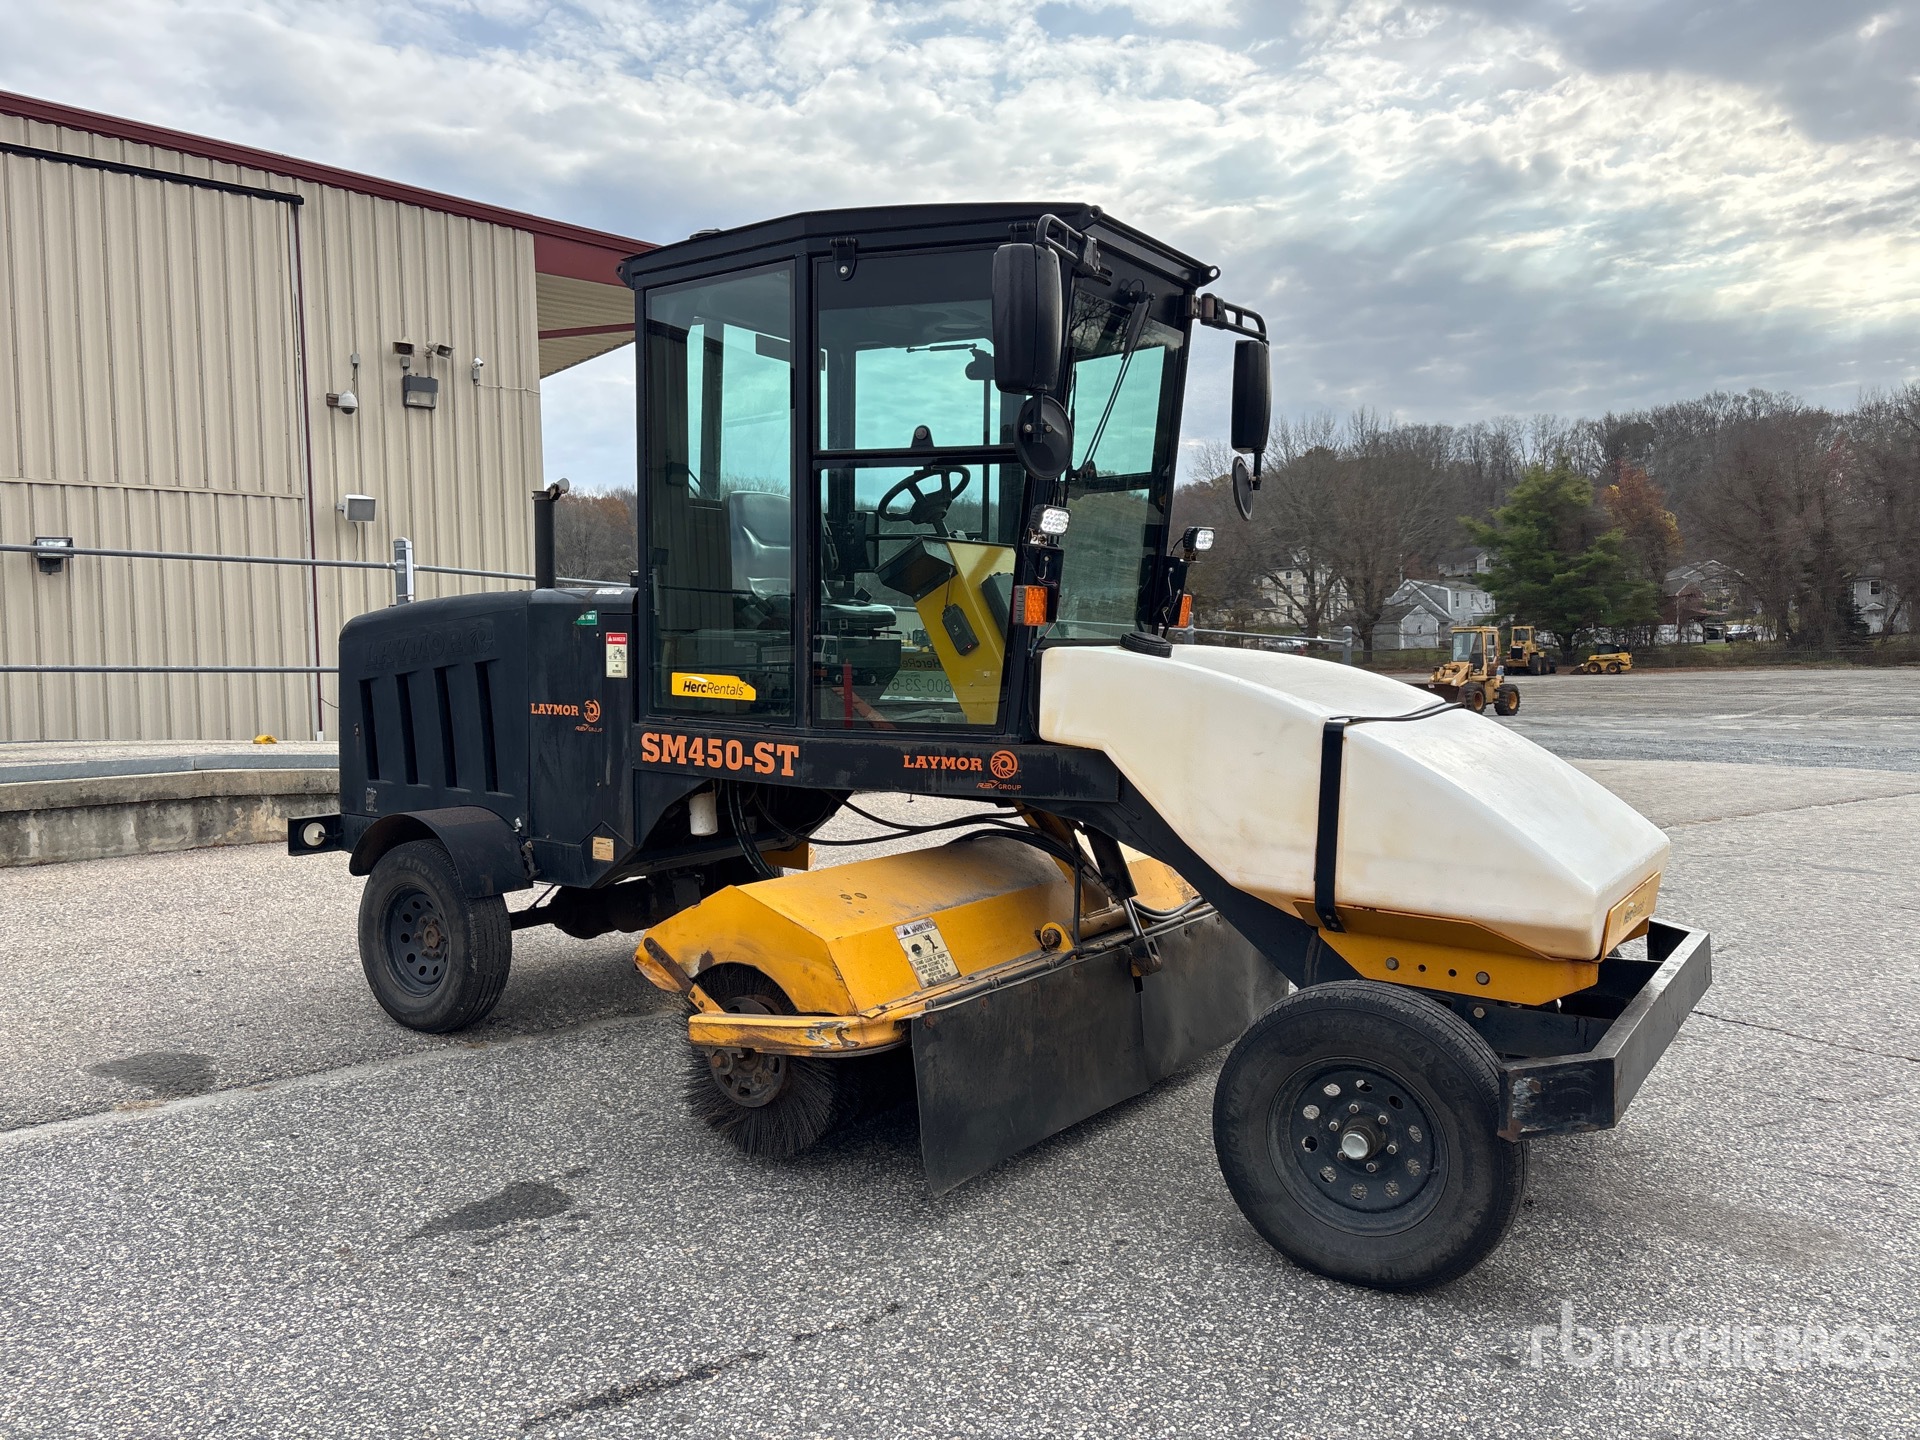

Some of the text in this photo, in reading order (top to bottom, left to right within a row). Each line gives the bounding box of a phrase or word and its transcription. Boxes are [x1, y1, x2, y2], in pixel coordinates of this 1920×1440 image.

[683, 681, 744, 696] HercRentals
[531, 703, 579, 717] LAYMOR
[641, 732, 800, 777] SM450-ST
[903, 755, 983, 771] LAYMOR
